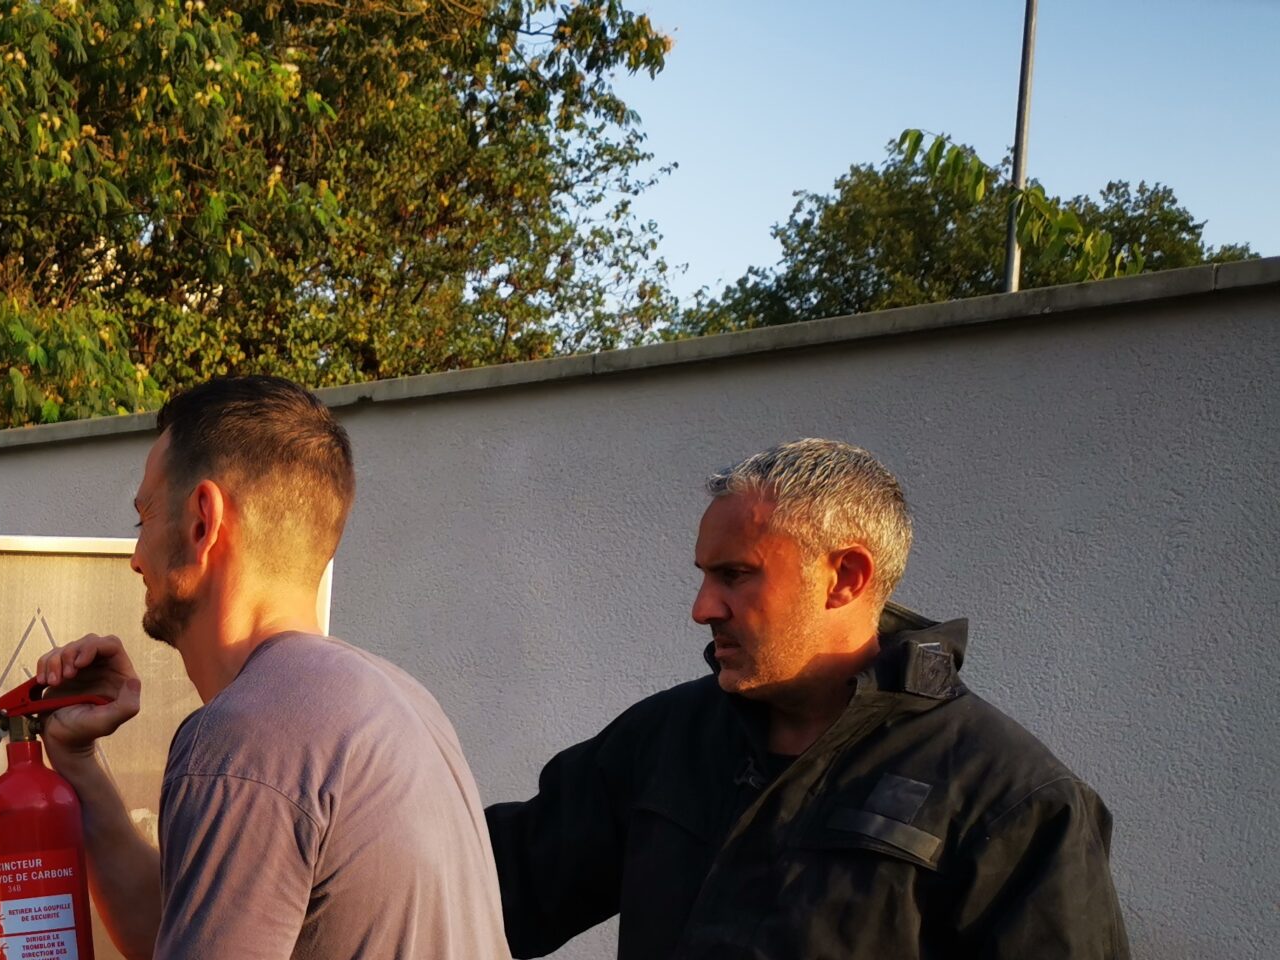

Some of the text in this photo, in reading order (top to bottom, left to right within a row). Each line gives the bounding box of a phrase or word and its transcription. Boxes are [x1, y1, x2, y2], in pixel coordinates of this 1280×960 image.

[15, 872, 28, 882] DE
[31, 867, 73, 880] CARBONE
[8, 907, 33, 916] RETIRER
[43, 903, 71, 912] GOUPILLE
[25, 935, 51, 943] DIRIGER
[22, 943, 56, 951] TROMBLON
[21, 950, 54, 958] DIRECTION
